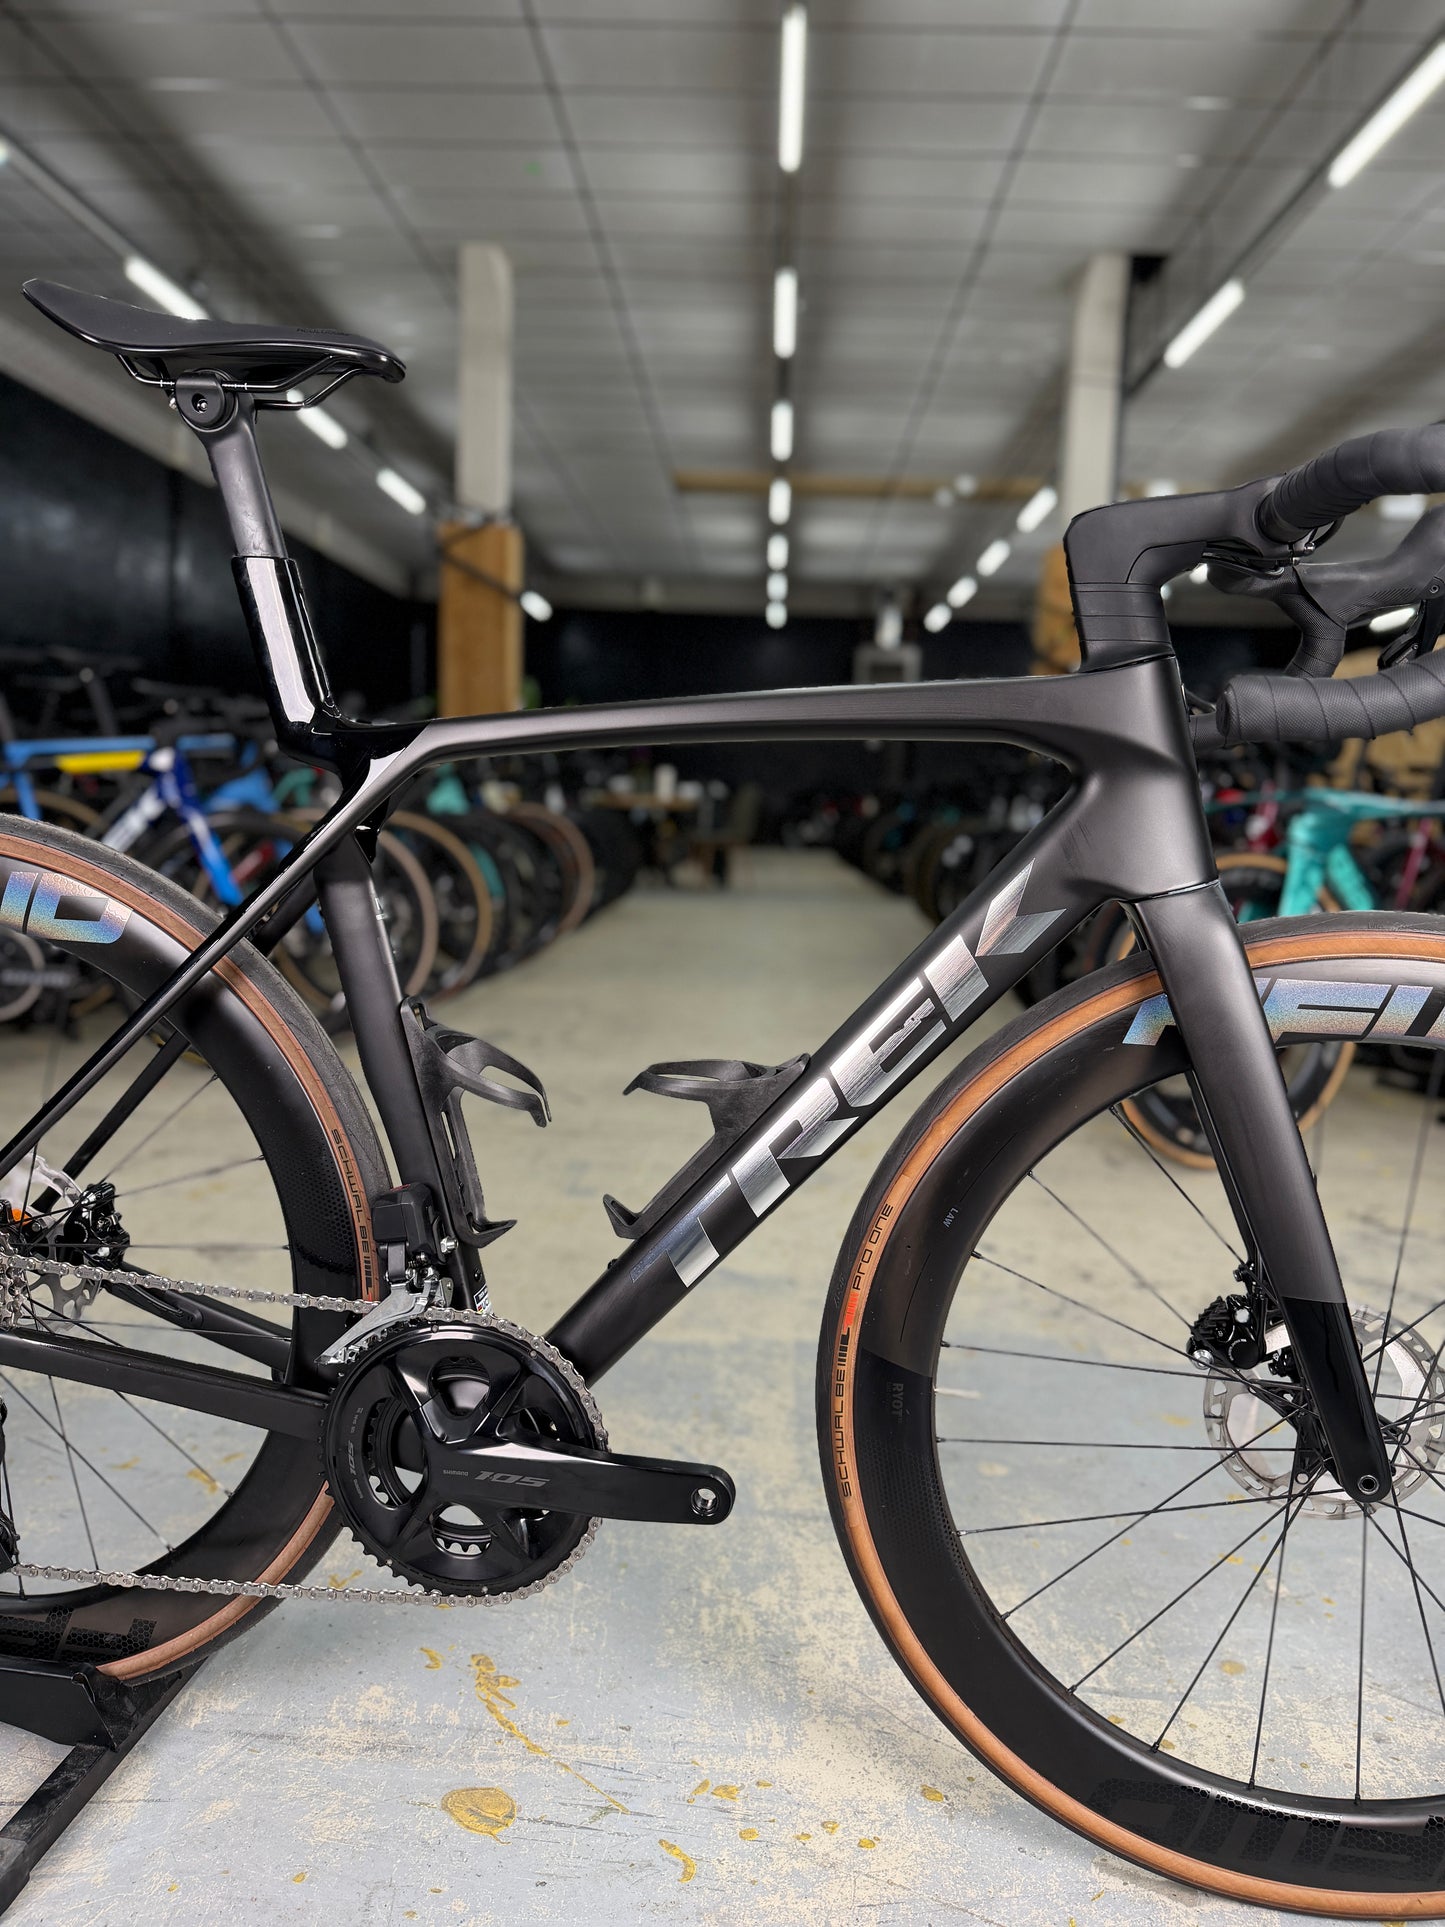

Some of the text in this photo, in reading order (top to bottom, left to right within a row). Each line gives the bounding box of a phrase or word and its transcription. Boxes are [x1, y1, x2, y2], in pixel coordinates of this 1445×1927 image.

[630, 858, 1066, 1288] TREK
[332, 1129, 370, 1254] SCHWALBE
[943, 1208, 959, 1228] LAW
[835, 1368, 852, 1497] SCHWALBE
[892, 1383, 904, 1416] RYOT
[475, 1470, 551, 1488] 105
